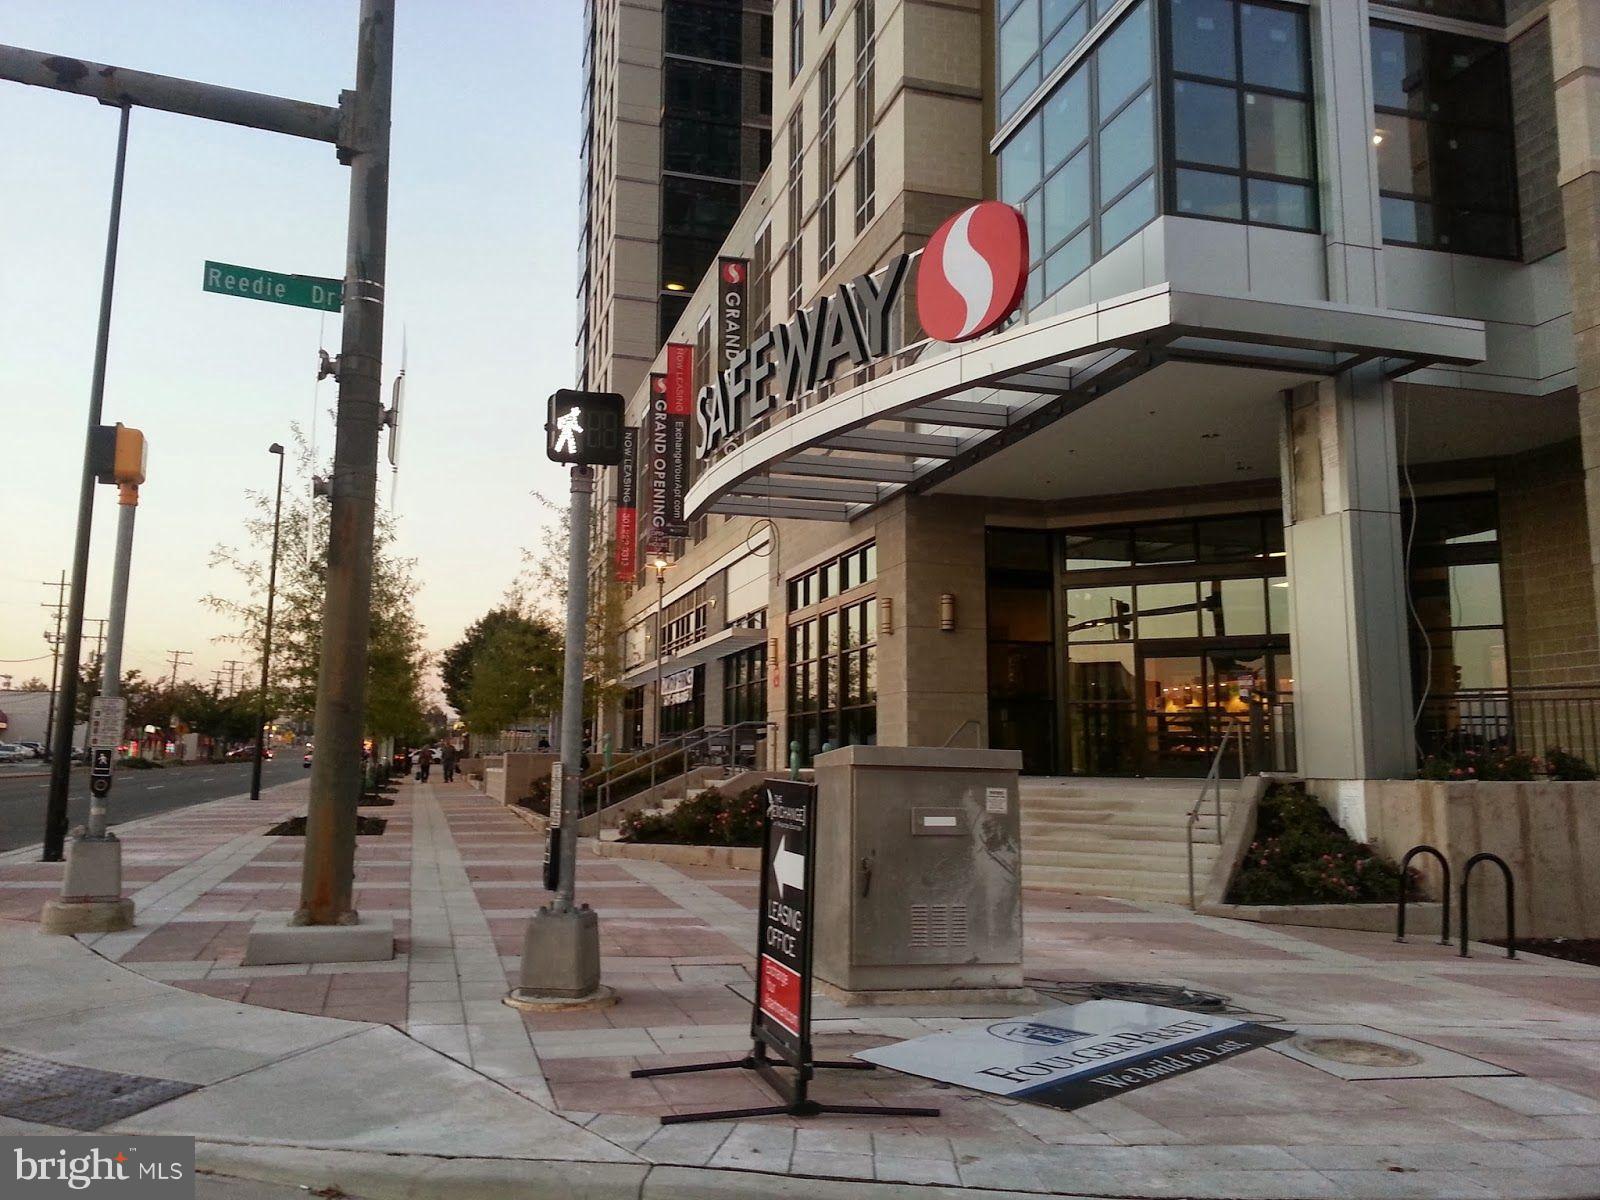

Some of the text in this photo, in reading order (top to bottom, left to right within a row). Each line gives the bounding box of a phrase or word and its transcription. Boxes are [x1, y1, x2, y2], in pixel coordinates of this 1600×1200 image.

[208, 267, 336, 306] Reedie Dr
[696, 253, 910, 460] SAFEWAY
[653, 399, 668, 453] GRAND
[623, 432, 633, 503] NOW LEASING
[652, 459, 667, 528] OPENING
[768, 899, 802, 931] LEASING
[767, 925, 797, 957] OFFICE
[1089, 1071, 1139, 1089] We
[1132, 1056, 1190, 1079] Build
[1183, 1047, 1208, 1064] to
